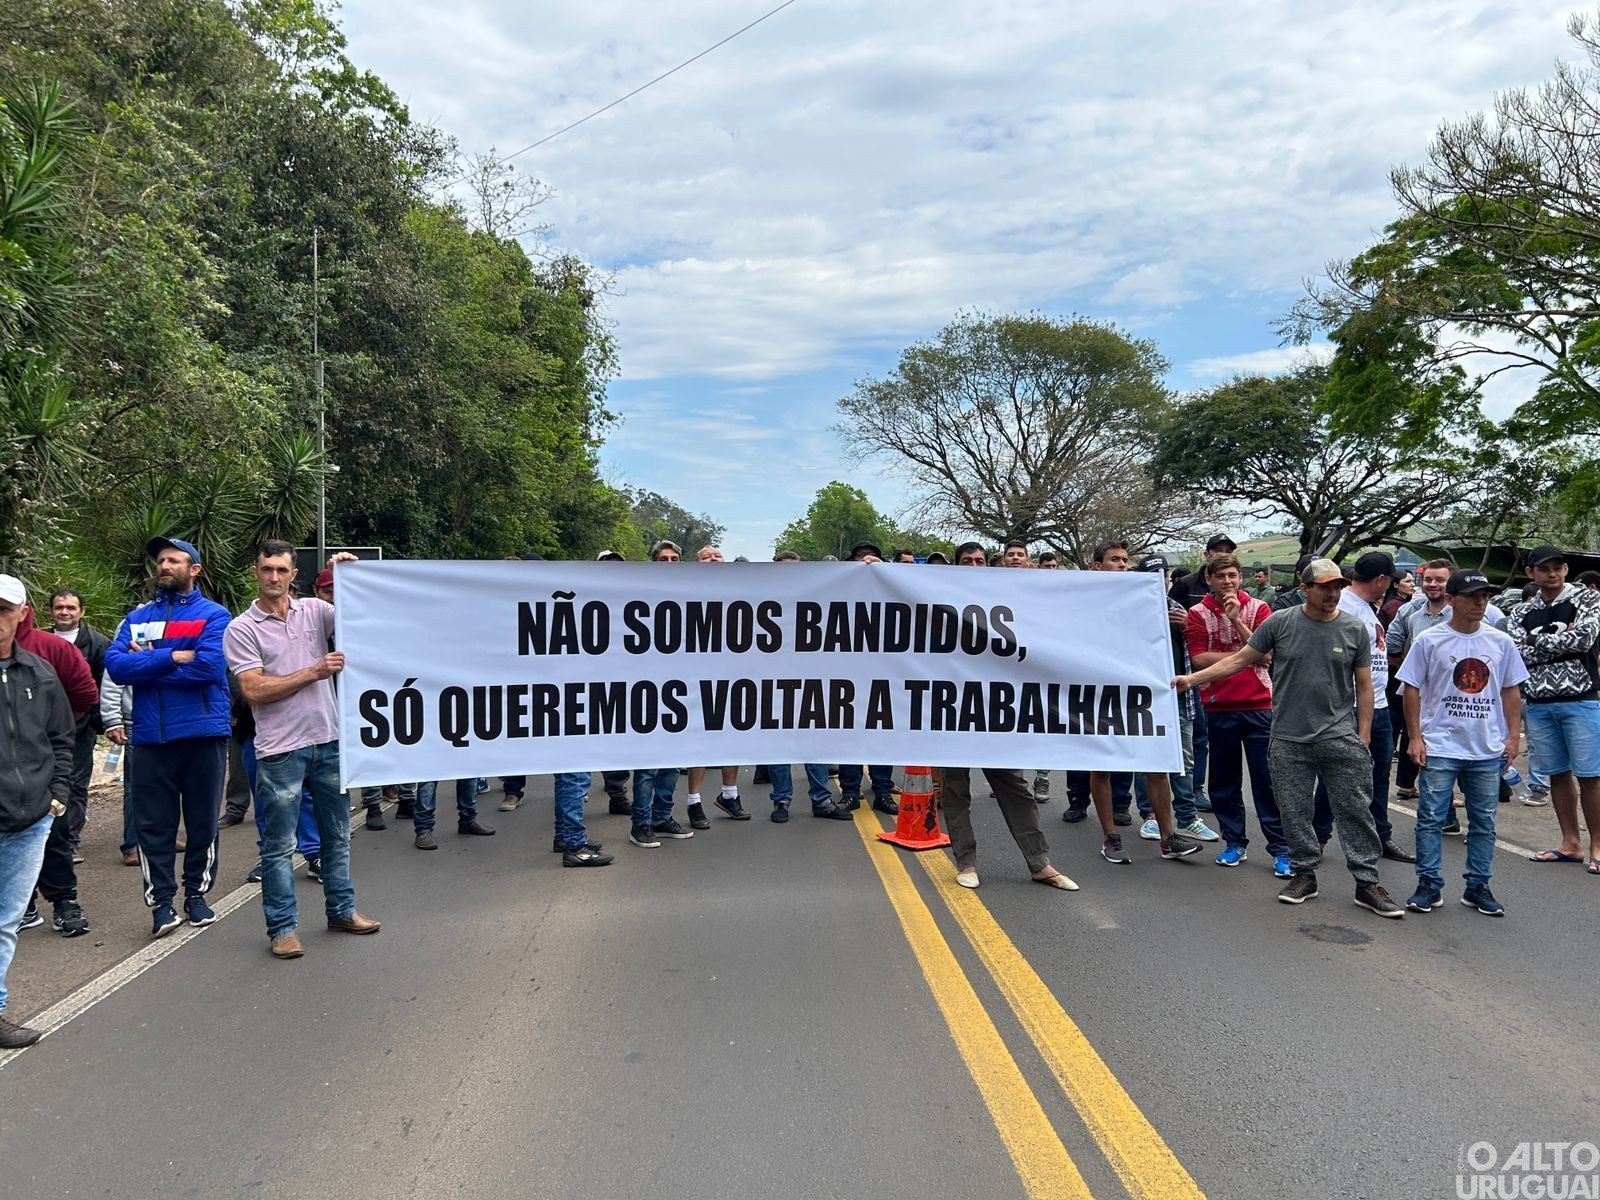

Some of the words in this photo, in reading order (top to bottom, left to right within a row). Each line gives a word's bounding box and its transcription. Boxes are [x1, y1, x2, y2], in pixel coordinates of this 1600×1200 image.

[517, 590, 610, 656] NÃO
[623, 600, 783, 656] SOMOS
[794, 601, 1027, 663] BANDIDOS,
[358, 677, 424, 748] SÓ
[438, 679, 689, 748] QUEREMOS
[698, 678, 856, 732] VOLTAR
[864, 679, 894, 730] A
[904, 679, 1167, 737] TRABALHAR.
[1441, 695, 1469, 704] NOSSA
